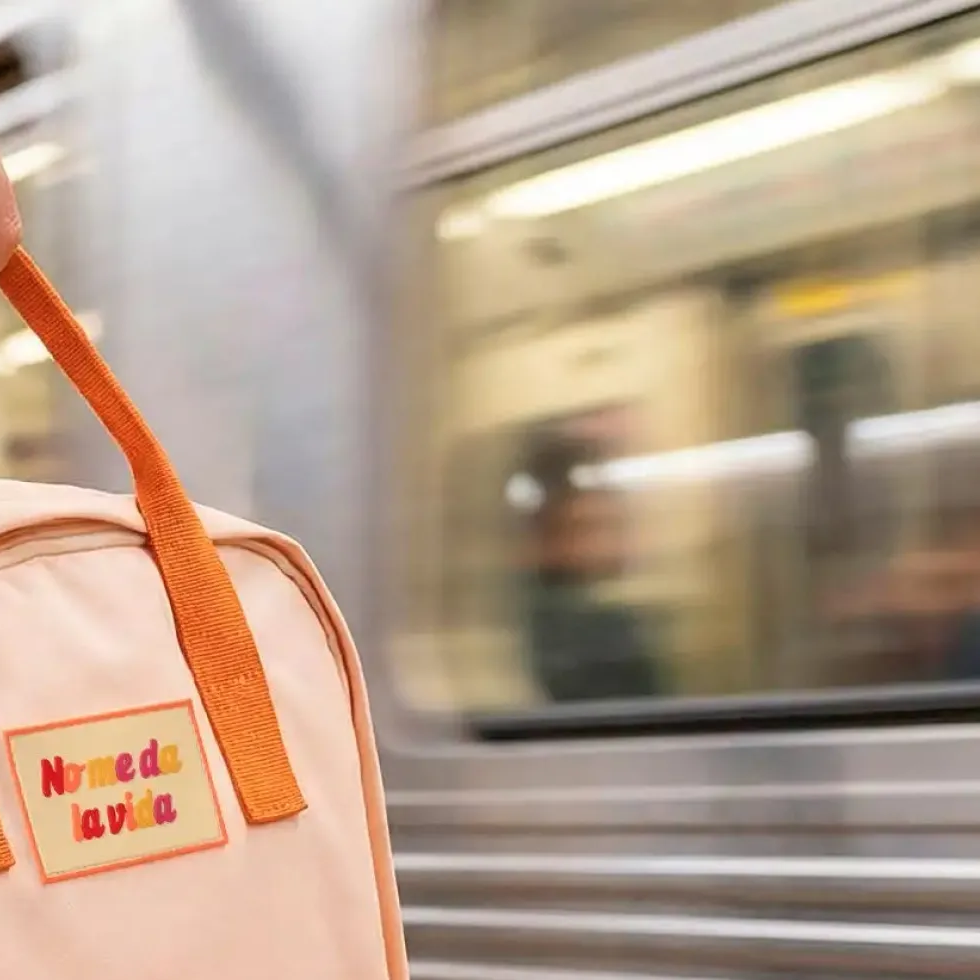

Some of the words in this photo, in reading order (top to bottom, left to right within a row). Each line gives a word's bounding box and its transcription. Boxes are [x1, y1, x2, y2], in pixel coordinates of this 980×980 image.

[40, 756, 85, 798] No
[87, 752, 135, 789] me
[139, 738, 183, 778] da
[71, 803, 105, 842] la
[107, 789, 177, 835] vida
